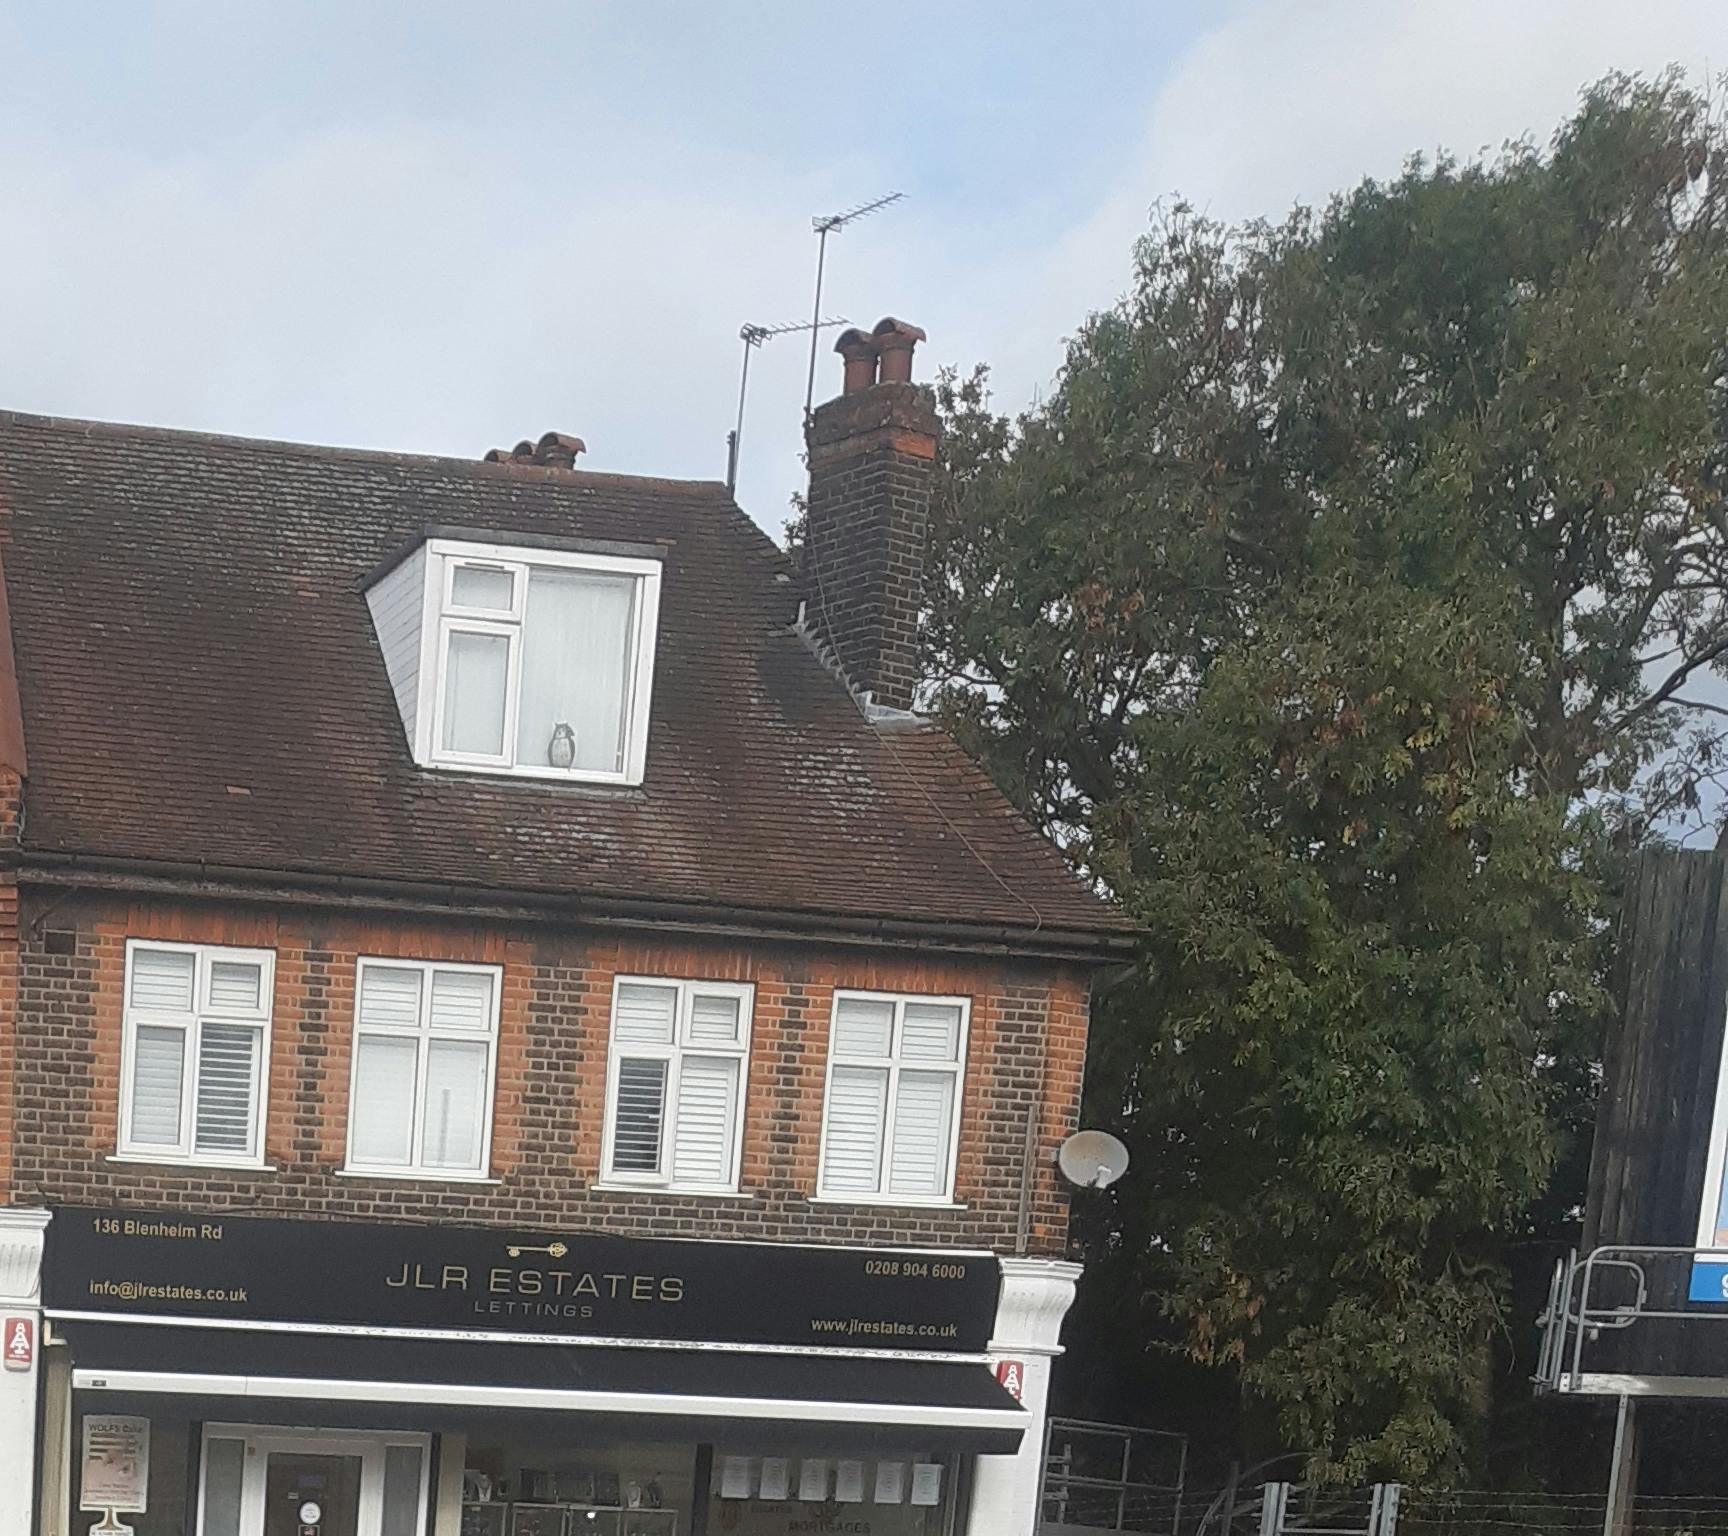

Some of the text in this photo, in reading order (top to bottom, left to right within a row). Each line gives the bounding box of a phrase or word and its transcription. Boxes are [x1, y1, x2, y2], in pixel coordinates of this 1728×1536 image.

[93, 1218, 223, 1240] 136 Blenheim Rd
[865, 1260, 966, 1280] 0208 904 6000
[90, 1280, 247, 1301] info@jlrestates.co.uk
[386, 1263, 685, 1302] JLR ESTATES
[474, 1300, 593, 1318] LETTINGS
[811, 1319, 958, 1338] www.jlrestates.co.uk
[789, 1522, 870, 1534] MORTGAGES
